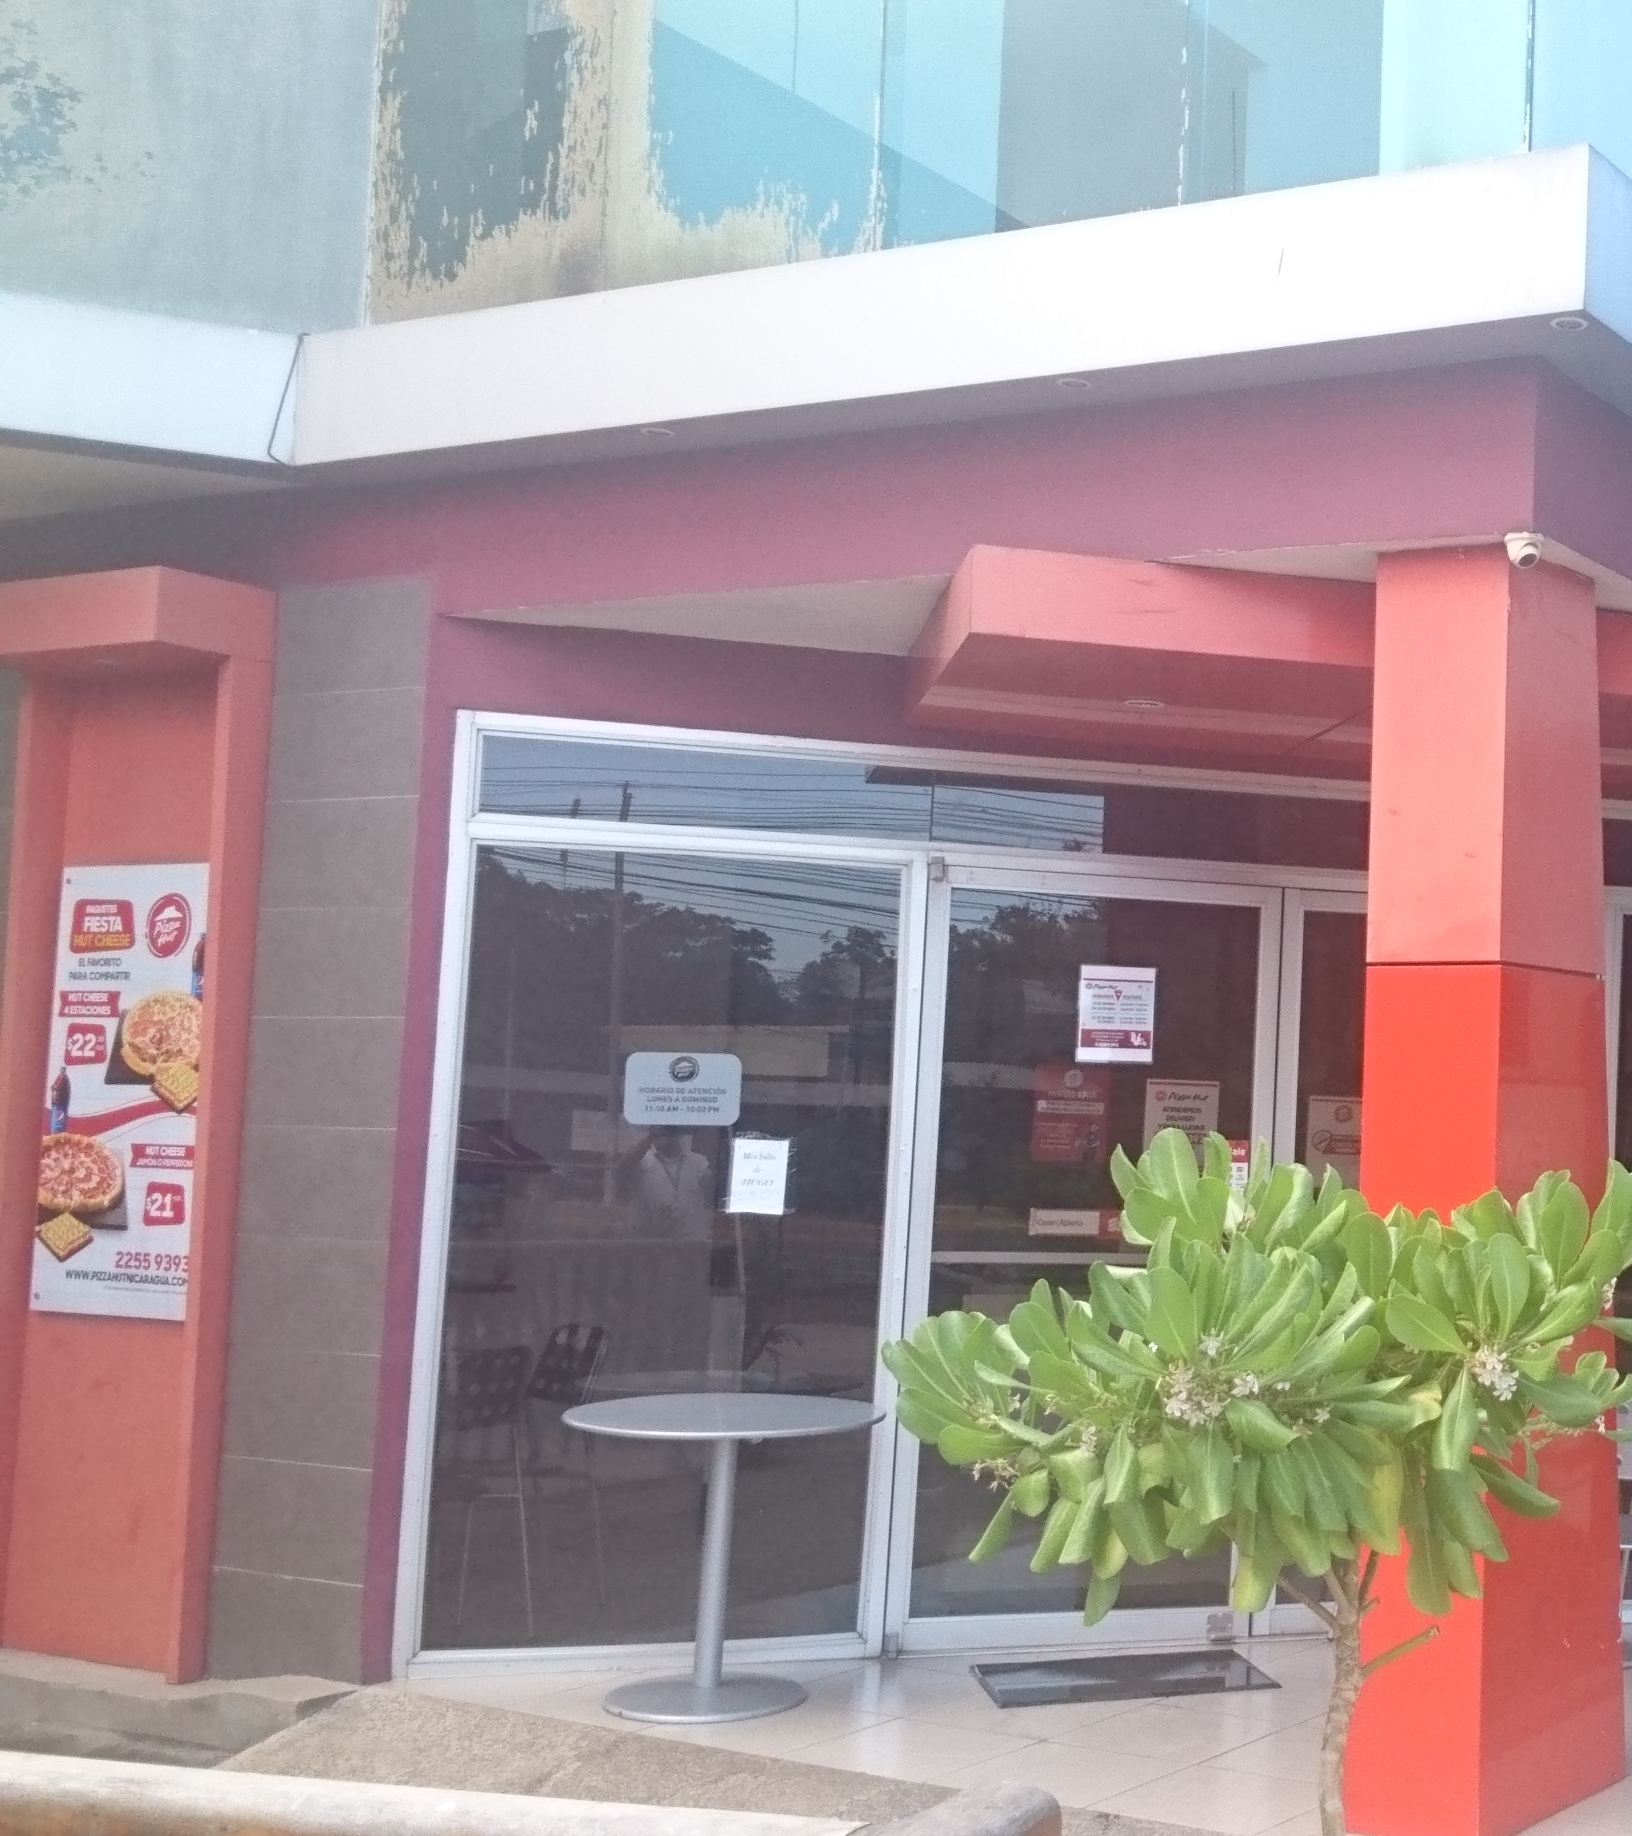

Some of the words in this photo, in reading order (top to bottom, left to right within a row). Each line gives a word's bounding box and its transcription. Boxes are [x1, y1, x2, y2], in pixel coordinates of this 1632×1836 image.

[83, 916, 123, 932] FIESTA
[153, 919, 181, 938] Pizza
[74, 934, 95, 947] HUT
[96, 934, 130, 947] CHEESE
[158, 931, 178, 948] Hut
[78, 958, 86, 967] EL
[87, 958, 122, 967] FAVORITO
[69, 972, 88, 981] PARA
[89, 971, 131, 981] COMPARTIR
[68, 993, 82, 1002] HUT
[83, 993, 109, 1002] CHEESE
[639, 1087, 674, 1095] HORARIO
[676, 1087, 686, 1095] DE
[682, 1096, 719, 1104] DOMINGO
[145, 1145, 160, 1155] HUT
[160, 1146, 186, 1157] CHEESE
[115, 1251, 152, 1271] 2255
[154, 1254, 189, 1273] 9393
